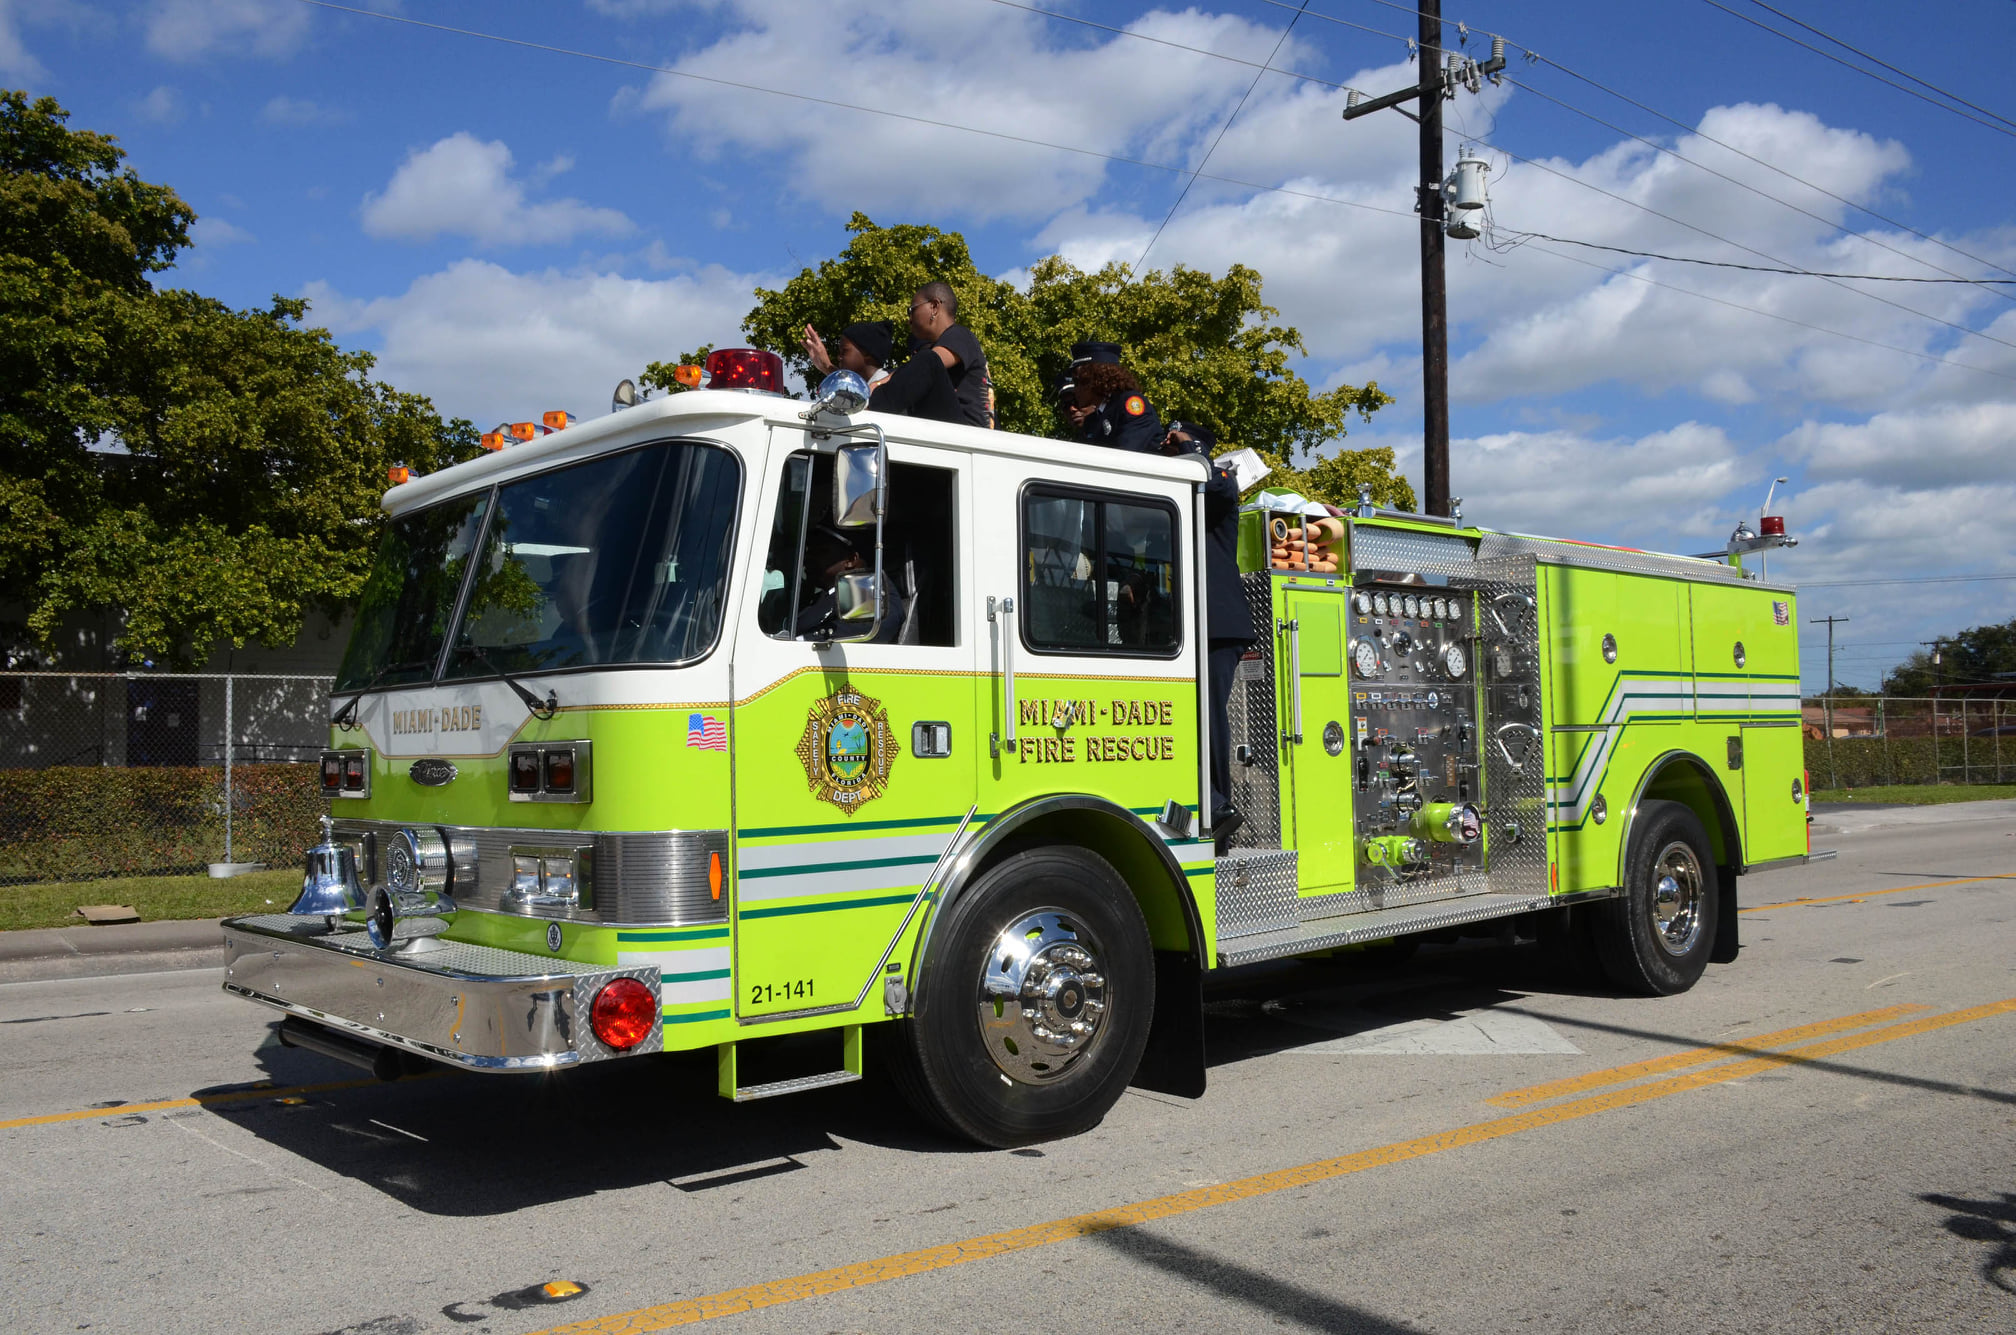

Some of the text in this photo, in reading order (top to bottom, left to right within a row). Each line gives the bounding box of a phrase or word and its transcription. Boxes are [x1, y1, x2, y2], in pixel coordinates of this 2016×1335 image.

[837, 694, 862, 706] FIRE
[1019, 699, 1174, 726] MIAMI-DADE
[393, 705, 482, 735] MIAMI-DADE
[828, 713, 869, 733] MIAMI-DADE
[877, 722, 885, 775] RESCUE
[1020, 735, 1175, 763] FIRE RESCUE
[831, 772, 866, 786] FLORIDA
[832, 790, 867, 803] DEPT.
[751, 979, 814, 1005] 21-141
